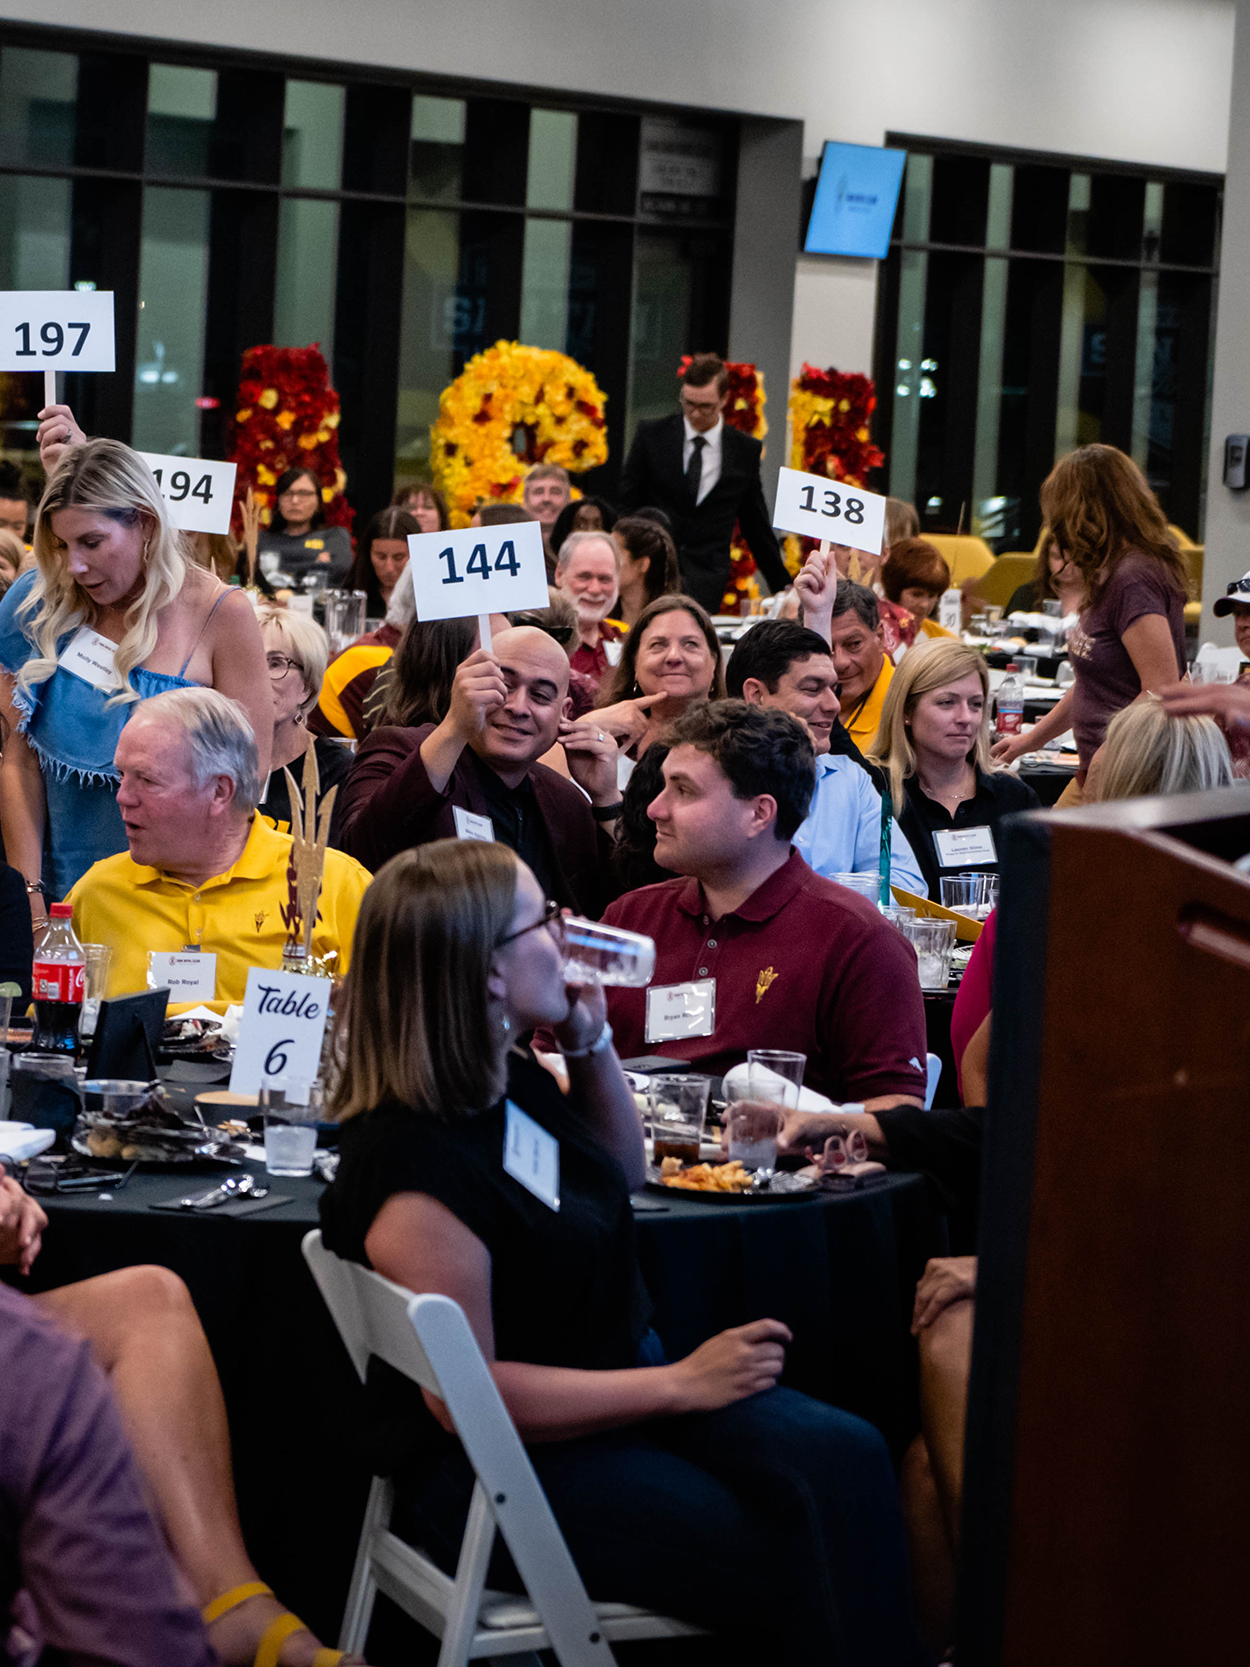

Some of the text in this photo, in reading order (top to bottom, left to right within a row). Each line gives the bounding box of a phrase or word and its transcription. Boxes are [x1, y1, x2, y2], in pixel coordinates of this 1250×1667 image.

[14, 321, 91, 357] 197
[152, 468, 213, 504] 194
[798, 484, 865, 525] 138
[438, 540, 521, 585] 144
[77, 651, 91, 664] Molly
[167, 978, 200, 987] Rob Royal
[257, 983, 320, 1020] Table
[263, 1038, 296, 1076] 6
